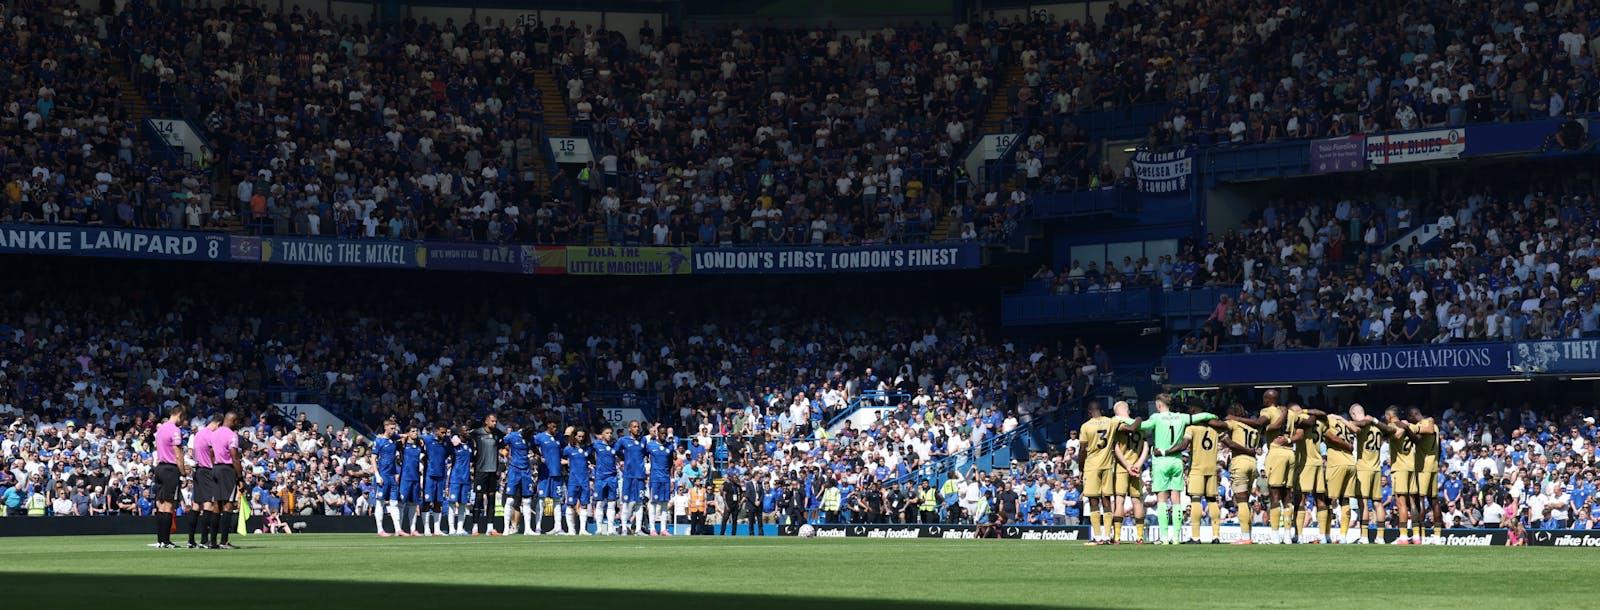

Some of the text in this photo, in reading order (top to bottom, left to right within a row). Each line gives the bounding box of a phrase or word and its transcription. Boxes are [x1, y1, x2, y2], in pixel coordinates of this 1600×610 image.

[519, 14, 537, 28] 15
[158, 121, 173, 133] 14
[559, 140, 575, 151] 15
[995, 135, 1010, 147] 16
[1368, 141, 1404, 158] PHILLY
[1408, 137, 1442, 155] BLUES
[1145, 179, 1177, 193] LONDON
[80, 231, 198, 255] LAMPARD
[208, 239, 219, 259] 8
[281, 241, 406, 265] TAKING THE MIKEL
[620, 247, 640, 257] THE
[695, 248, 959, 270] LONDON'S FIRST, LONDON'S FINEST
[571, 261, 663, 273] LITTLE MAGICIAN
[1562, 340, 1598, 360] THEY
[1336, 352, 1393, 371] WORLD
[1395, 348, 1492, 369] CHAMPIONS
[282, 405, 298, 419] 14
[607, 410, 623, 422] 15
[1096, 429, 1108, 449] 3
[1126, 430, 1142, 452] 19
[1169, 425, 1175, 445] 1
[1201, 430, 1213, 450] 6
[1243, 429, 1259, 449] 10
[1365, 430, 1382, 452] 20
[867, 528, 920, 538] nike football
[942, 529, 962, 539] nike
[1021, 529, 1079, 541] nike football
[1422, 533, 1493, 546] nie football
[1554, 534, 1582, 547] nike
